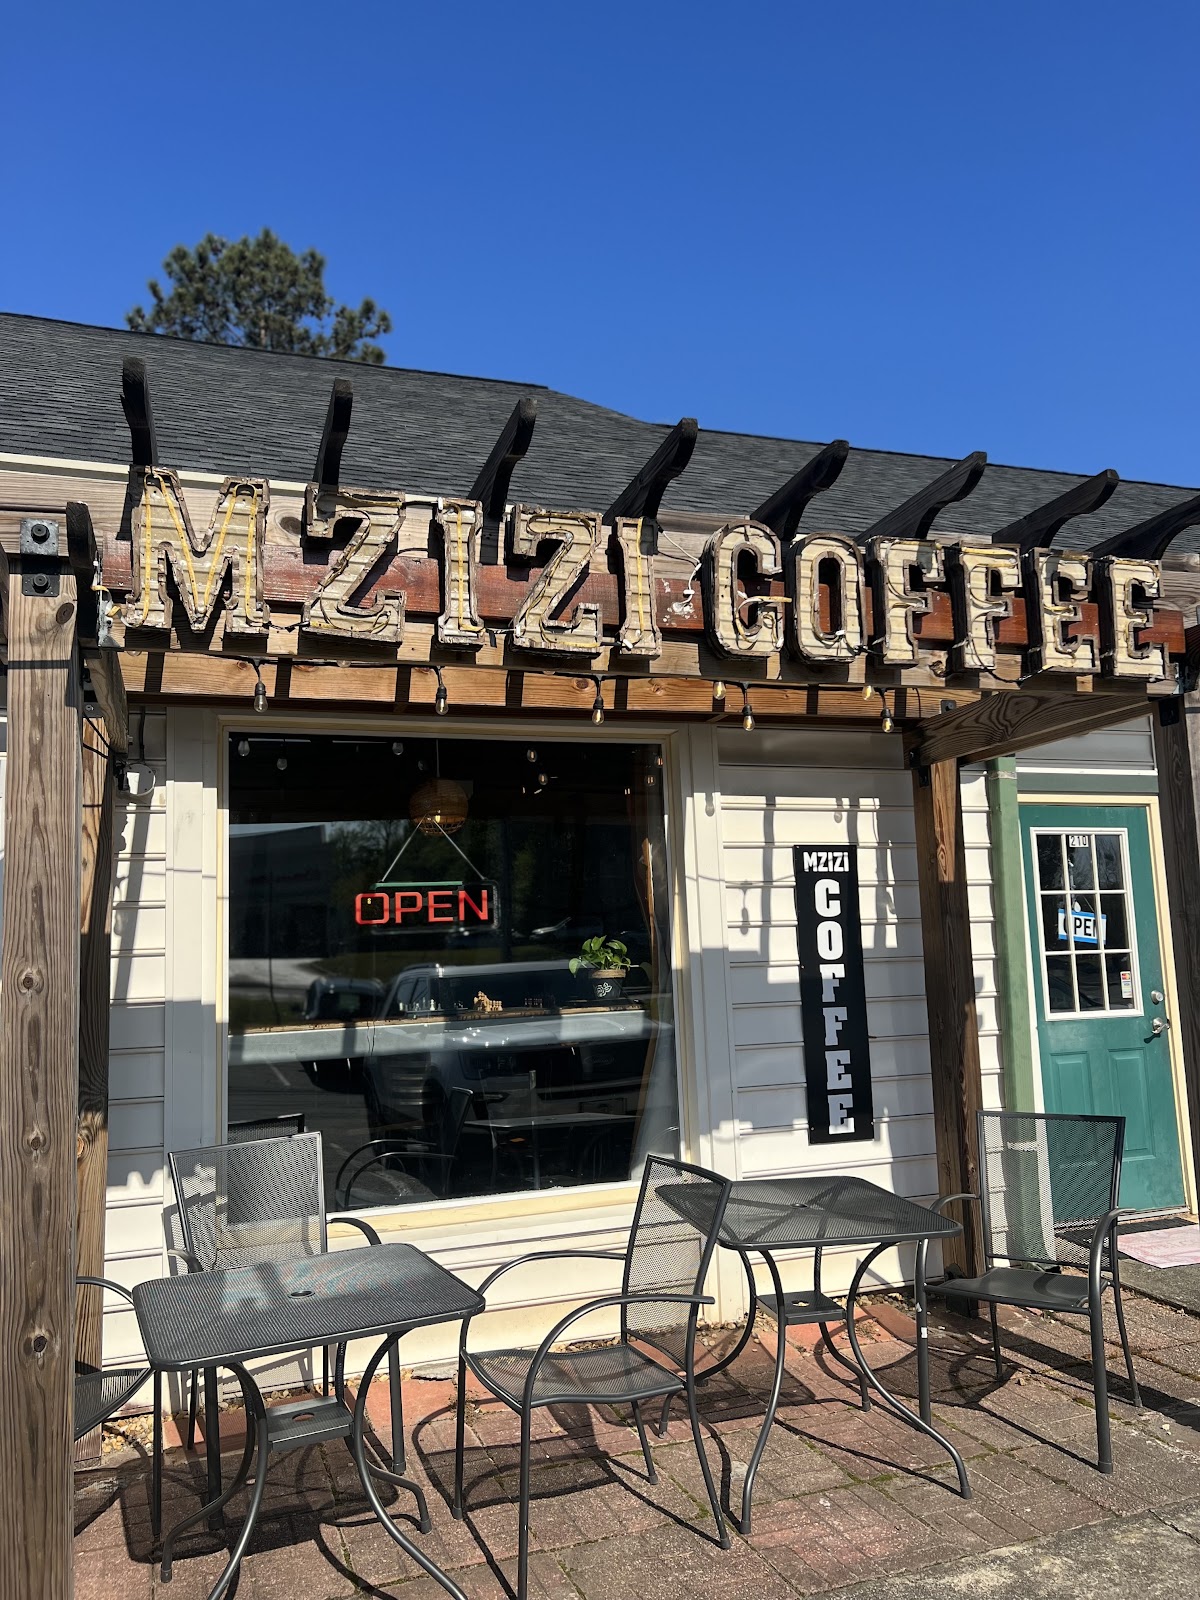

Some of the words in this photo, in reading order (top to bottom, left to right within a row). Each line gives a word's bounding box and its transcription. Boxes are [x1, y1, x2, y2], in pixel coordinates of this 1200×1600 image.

[122, 464, 663, 662] MZIZI
[704, 519, 1179, 682] COFFEE
[1070, 835, 1087, 846] 210
[803, 851, 849, 872] MZIZI
[355, 890, 488, 925] OPEN
[1063, 917, 1097, 937] PE
[814, 879, 855, 1135] COFFEE
